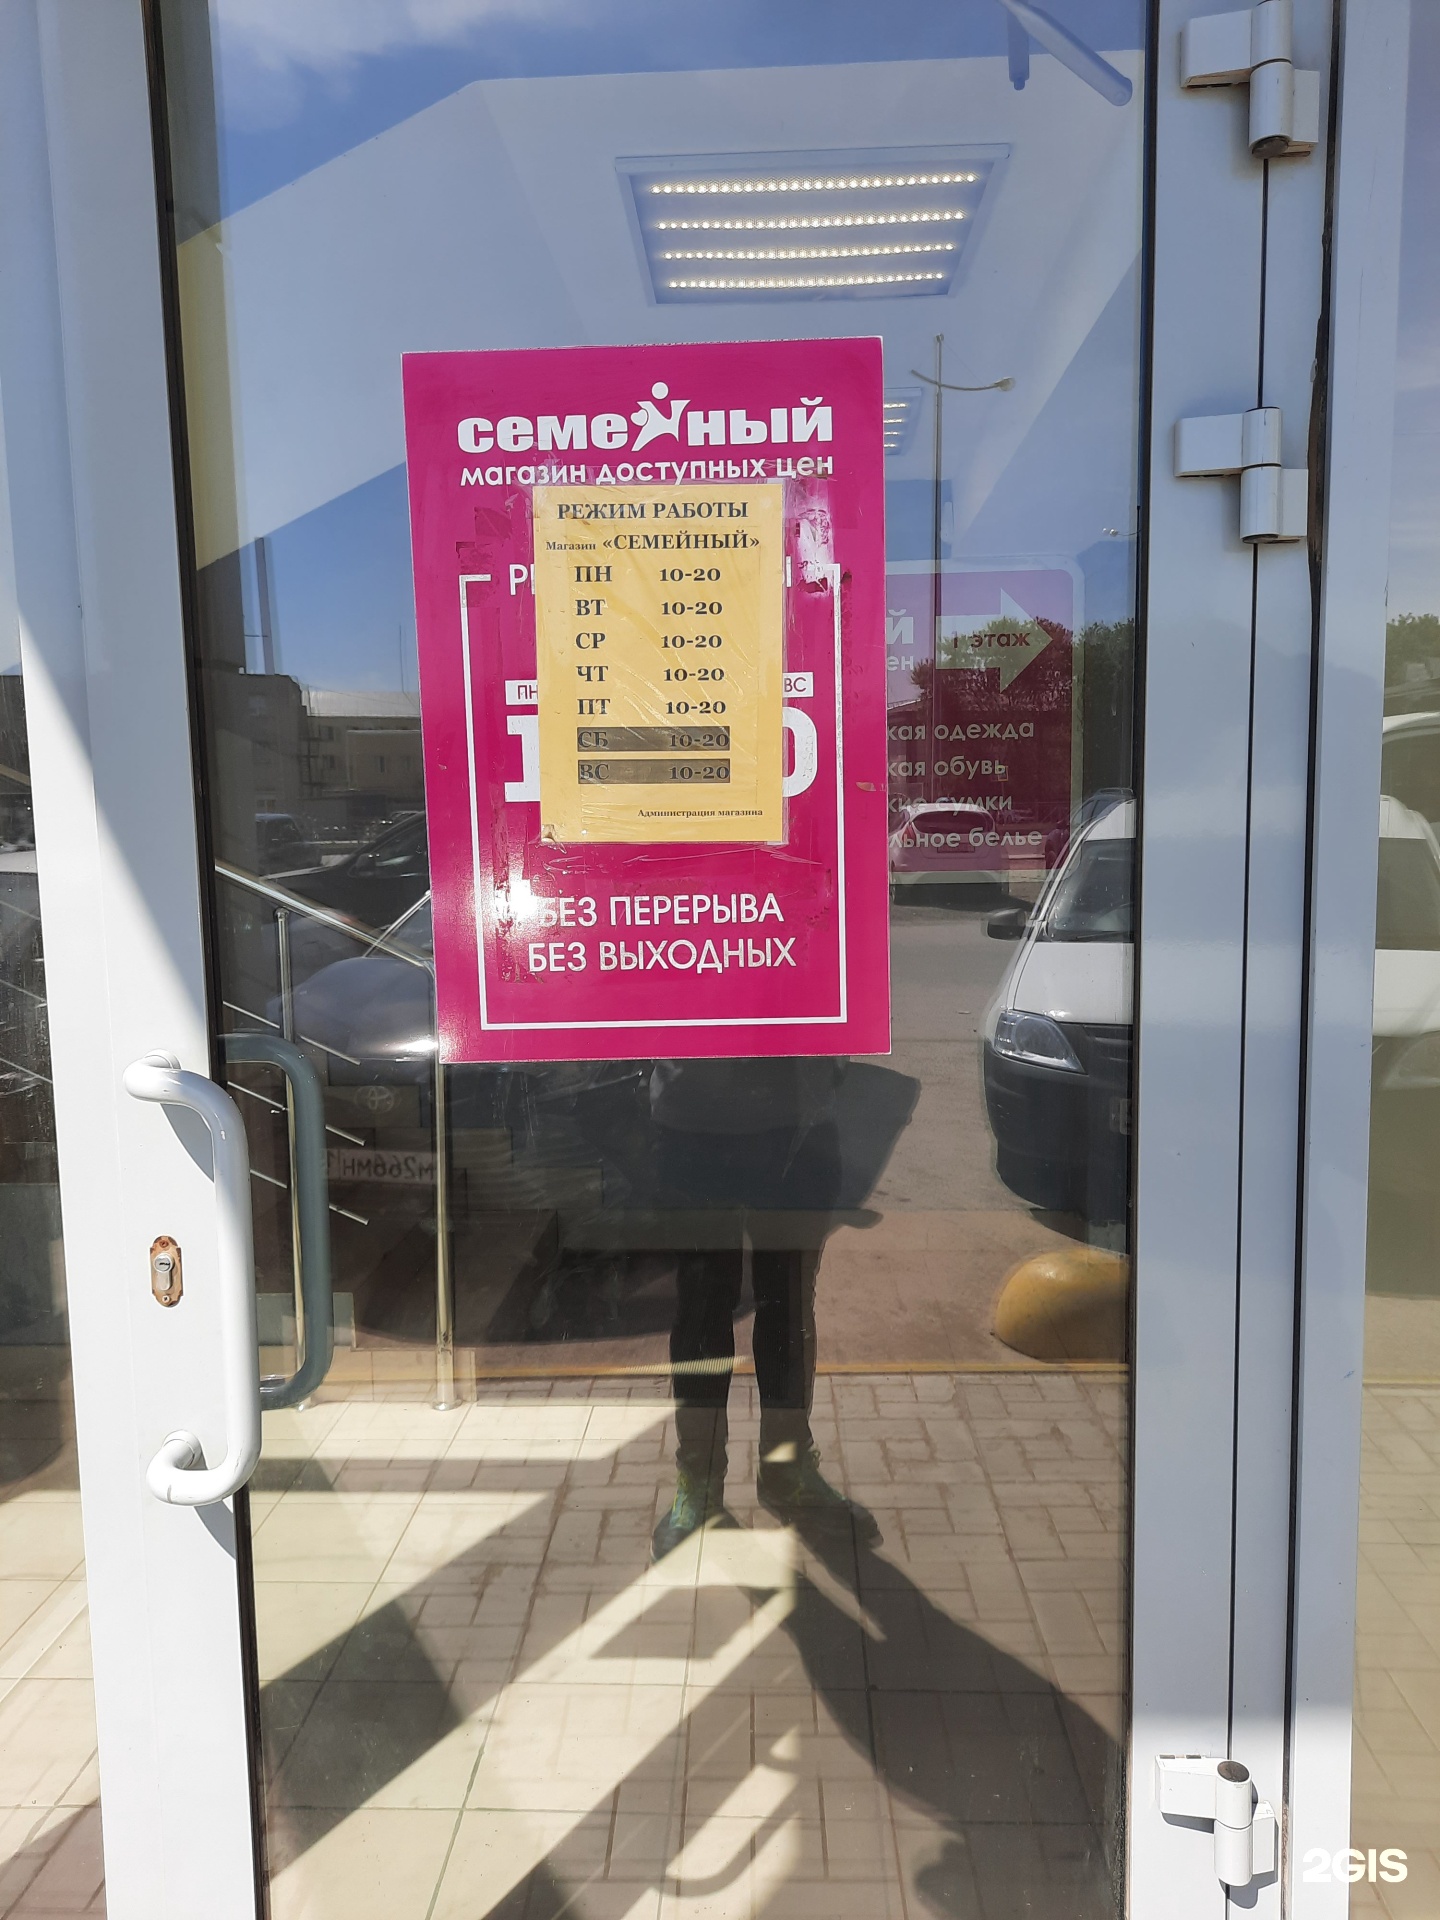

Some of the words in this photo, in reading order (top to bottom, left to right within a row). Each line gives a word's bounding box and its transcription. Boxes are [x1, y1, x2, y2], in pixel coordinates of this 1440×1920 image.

[460, 462, 586, 487] магазин
[595, 457, 766, 487] доступных
[775, 455, 834, 479] цен
[557, 503, 647, 521] РЕЖИМ
[652, 501, 748, 520] РАБОТЫ
[545, 541, 596, 551] Магазин
[602, 531, 760, 550] «СЕМЕЙНЫЙ»
[574, 565, 612, 583] ПН
[659, 567, 721, 583] 10-20
[576, 598, 605, 617] ВТ
[661, 601, 723, 616] 10-20
[575, 632, 606, 650] СР
[661, 634, 722, 649] 10-20
[970, 631, 1031, 648] этаж
[576, 665, 609, 682] ЧТ
[663, 667, 725, 682] 10-20
[577, 698, 611, 715] ПТ
[665, 700, 726, 715] 10-20
[577, 731, 608, 748] СБ
[668, 733, 729, 748] 10-20
[934, 722, 1034, 741] одежда
[579, 764, 610, 781] ВС
[669, 766, 729, 781] 10-20
[934, 756, 1006, 779] обувь
[638, 809, 716, 818] Администрация
[968, 827, 1043, 847] белье
[537, 897, 597, 927] БЕЗ
[609, 893, 784, 925] ПЕРЕРЫВА
[528, 942, 587, 972] БЕЗ
[600, 937, 797, 973] ВЫХОДНЫХ
